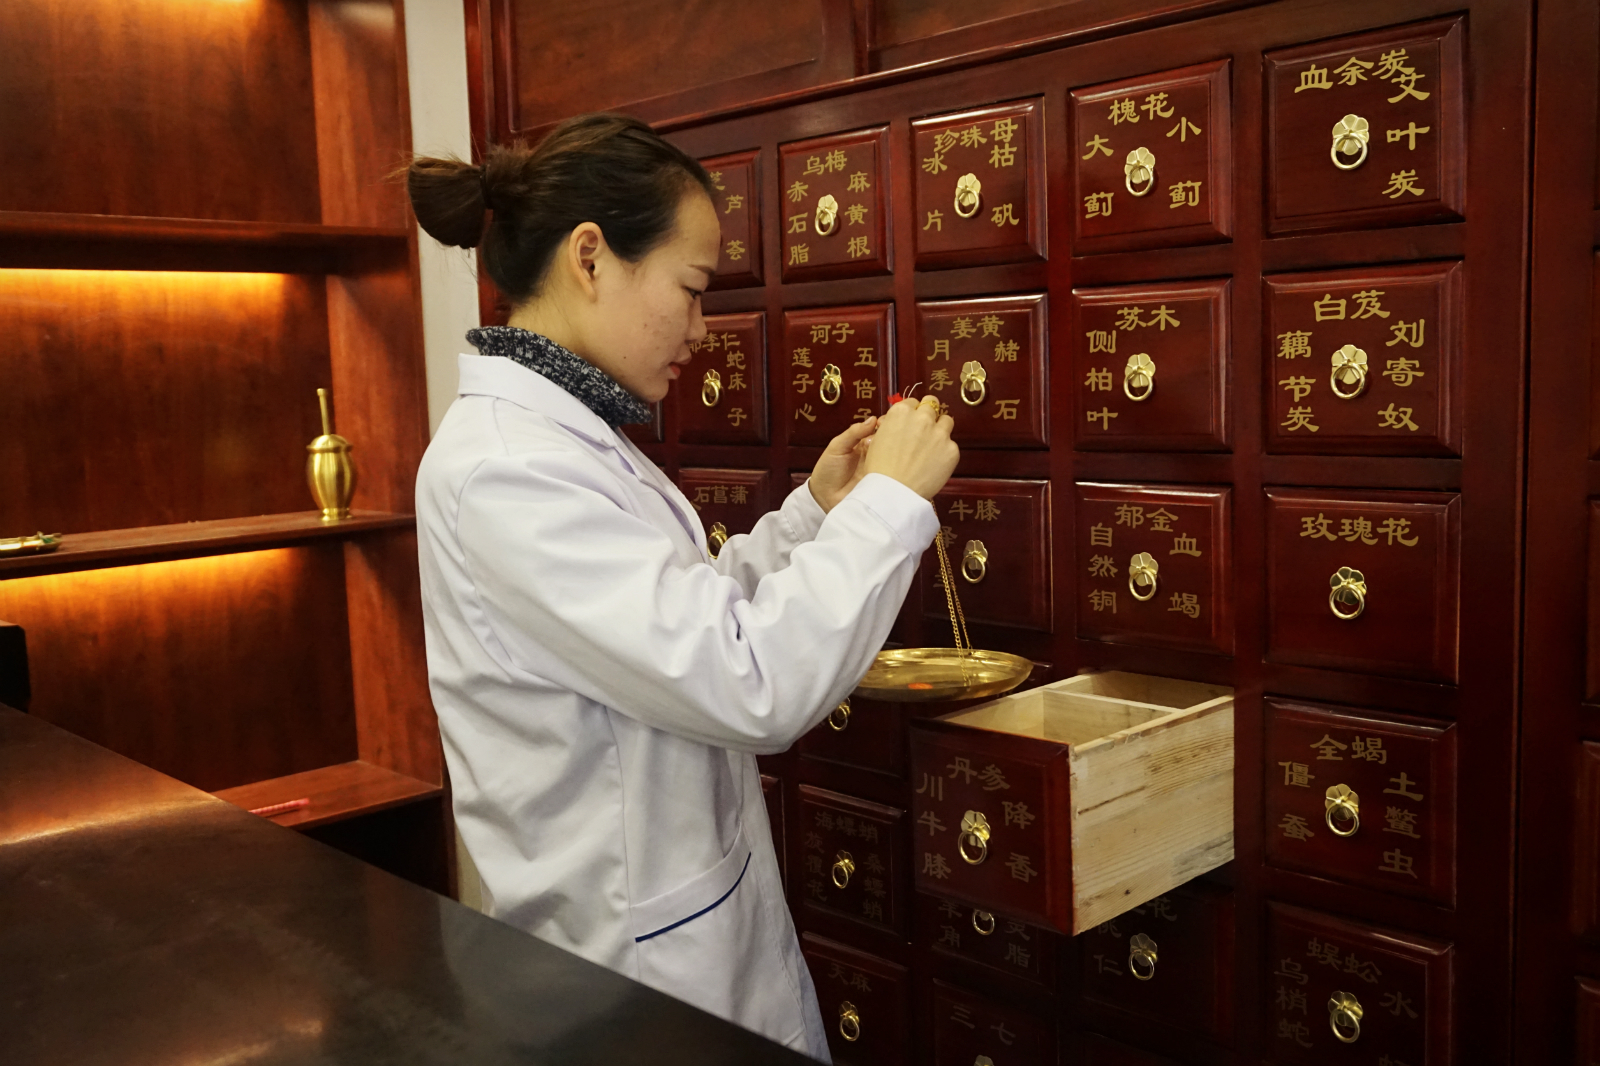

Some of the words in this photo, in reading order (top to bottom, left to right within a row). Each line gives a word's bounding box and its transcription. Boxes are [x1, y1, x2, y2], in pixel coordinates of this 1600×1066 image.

[1294, 48, 1415, 93] 血余炭
[934, 118, 1018, 153] 珍珠母
[1108, 92, 1174, 125] 槐花
[1382, 72, 1430, 199] 艾叶炭
[803, 150, 847, 175] 乌梅
[922, 153, 948, 231] 冰片
[989, 143, 1019, 227] 枯矾
[1082, 134, 1114, 219] 大蓟
[1166, 117, 1202, 209] 小蓟
[725, 194, 745, 260] 芦荟
[787, 181, 809, 266] 赤石脂
[845, 171, 871, 258] 麻黄根
[810, 323, 855, 344] 诃子
[950, 315, 1004, 339] 姜黄
[1115, 305, 1180, 331] 苏木
[1313, 290, 1390, 322] 白芨
[726, 350, 747, 426] 蛇床子
[792, 347, 816, 422] 莲子心
[992, 339, 1020, 420] 赭石
[1084, 330, 1118, 430] 侧柏叶
[1277, 330, 1319, 432] 藕节炭
[1377, 319, 1425, 431] 刘寄奴
[693, 485, 749, 504] 石菖蒲
[948, 499, 1001, 521] 牛膝
[1114, 504, 1179, 532] 郁金
[1300, 513, 1419, 547] 玫瑰花
[1088, 522, 1118, 614] 自然铜
[1167, 532, 1202, 618] 血竭
[946, 756, 1011, 791] 丹参
[1309, 734, 1387, 765] 全蝎
[916, 772, 951, 879] 川牛膝
[1278, 761, 1315, 842] 僵蚕
[1001, 801, 1038, 883] 降香
[828, 962, 872, 992] 天麻
[1306, 937, 1382, 984] 蜈蚣
[950, 1005, 1016, 1046] 三七
[1274, 957, 1314, 1048] 乌梢蛇
